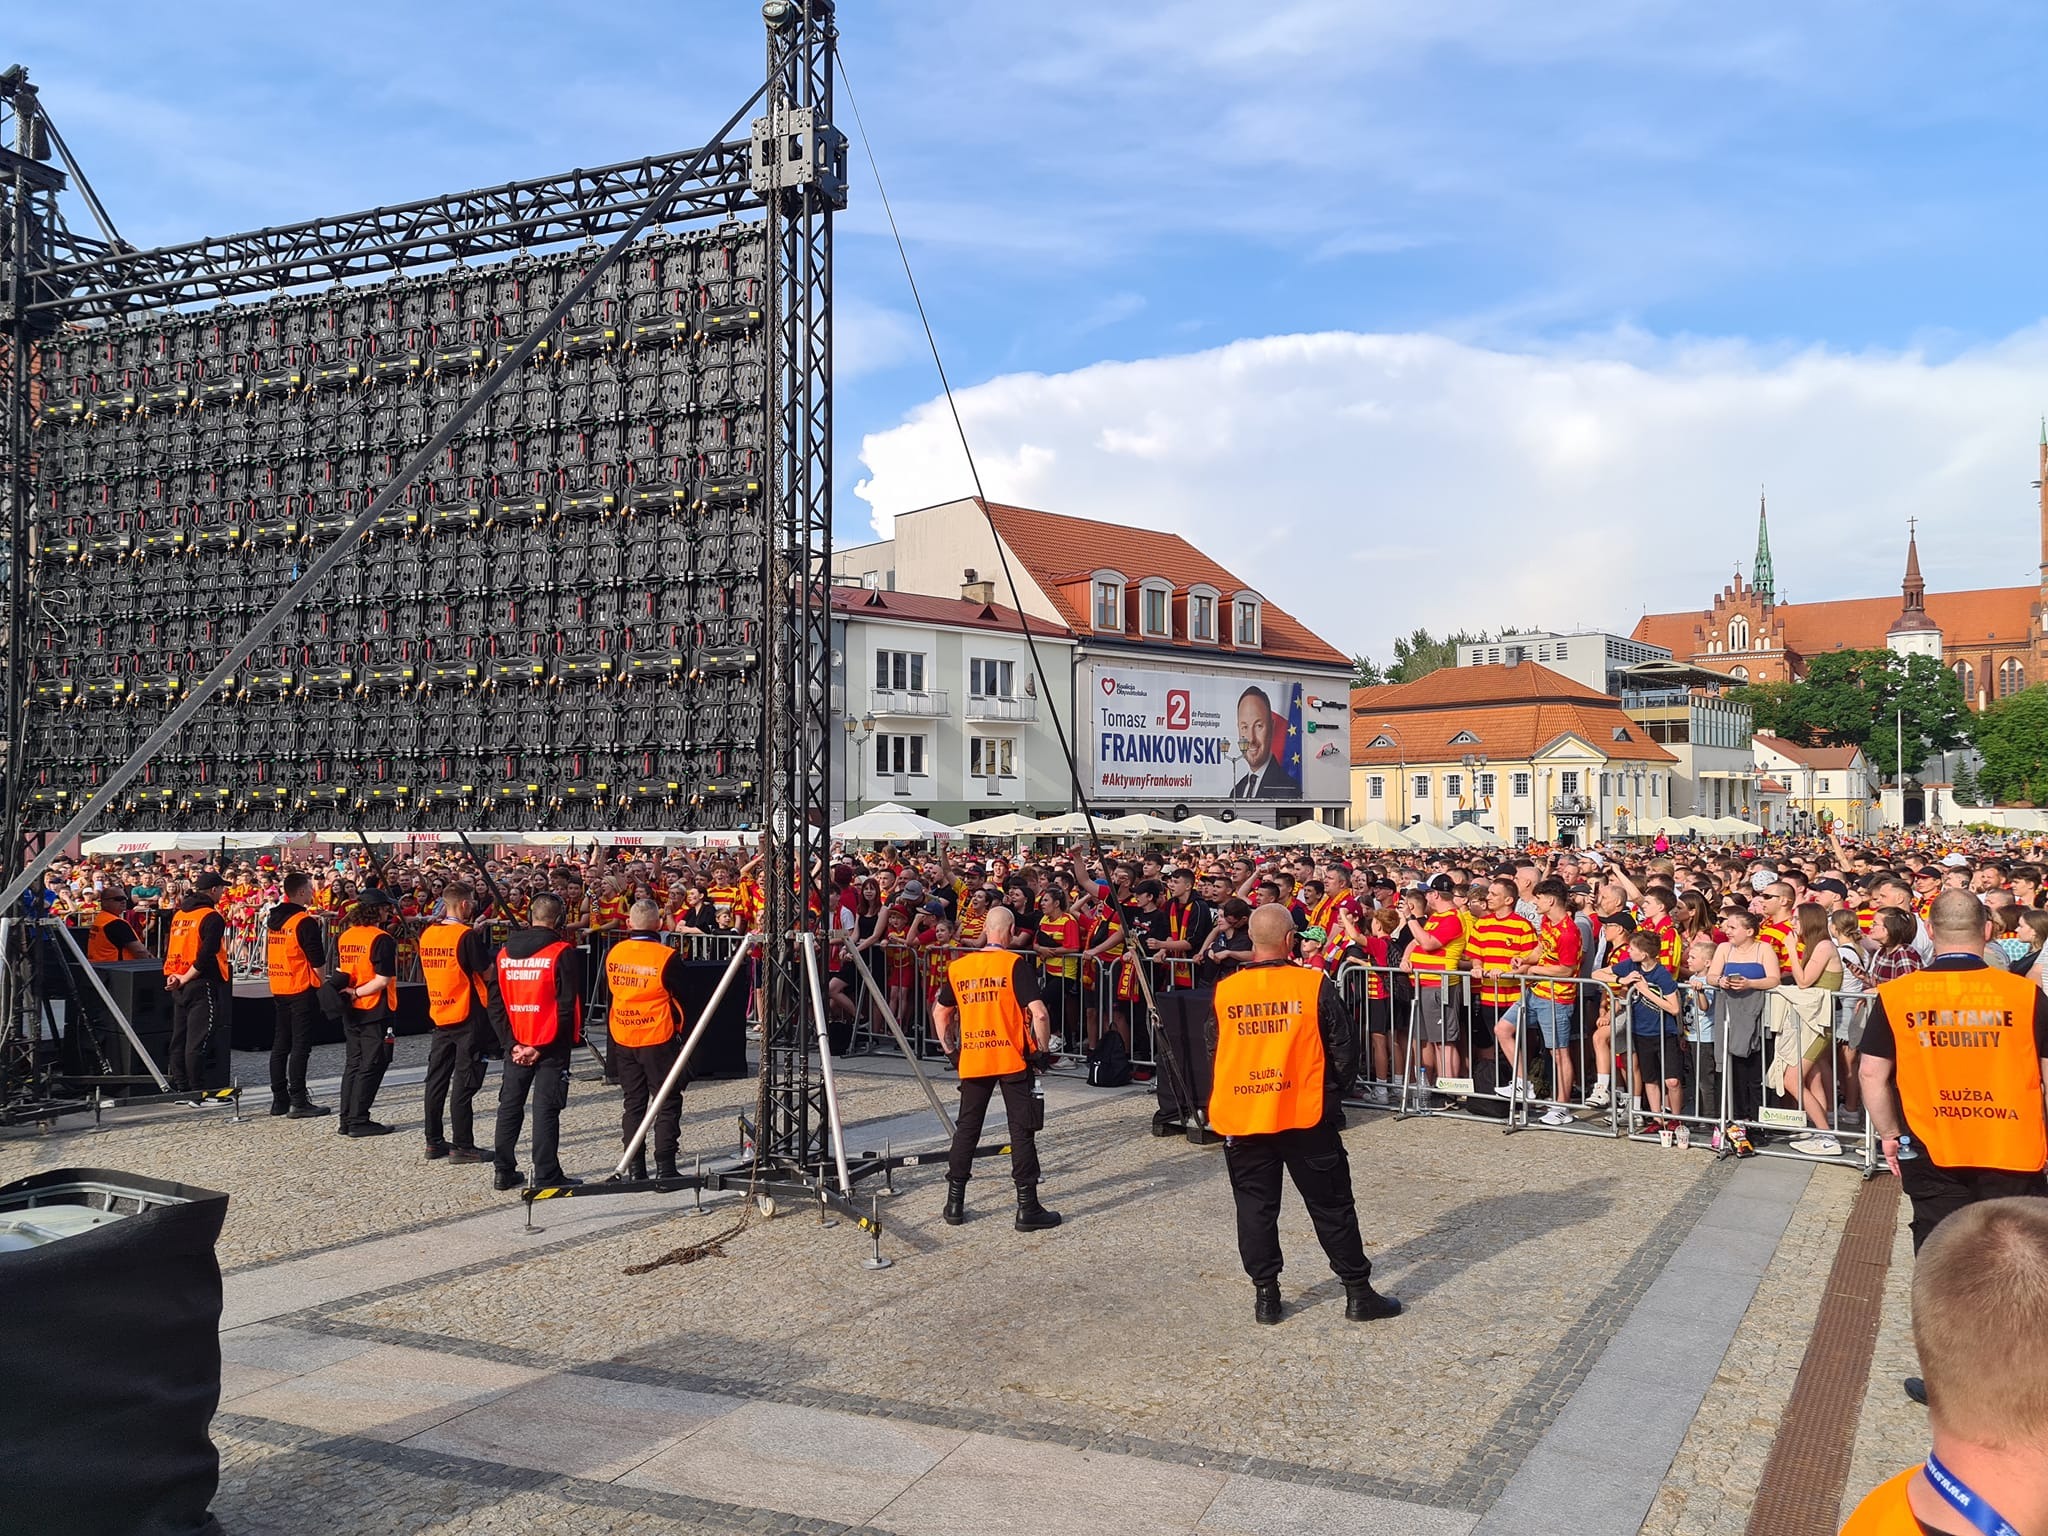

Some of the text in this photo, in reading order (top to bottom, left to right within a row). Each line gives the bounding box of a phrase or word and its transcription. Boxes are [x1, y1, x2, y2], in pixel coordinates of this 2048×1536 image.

[1156, 694, 1187, 726] nr 2
[1101, 708, 1146, 728] Tomasz
[1101, 733, 1221, 764] FRANKOWSKI
[1102, 773, 1193, 789] #AktywnyFrankowski
[500, 957, 551, 969] SPARTANIE
[608, 962, 658, 977] SPARTANIE
[506, 969, 541, 980] SECURITY
[612, 975, 649, 989] SECURITY
[957, 976, 1007, 993] SPARTANIE
[962, 990, 999, 1005] SECURITY
[1227, 1001, 1302, 1019] SPARTANIE
[1906, 1010, 2013, 1028] SPARTANIE
[1238, 1018, 1290, 1036] SECURITY
[963, 1039, 1011, 1051] RZĄDKOWA
[1919, 1031, 2000, 1048] SECURITY
[1249, 1067, 1283, 1080] SŁUŻBA
[1234, 1080, 1291, 1095] PORZĄDKOWA
[1940, 1088, 1994, 1102] SŁUŻBA
